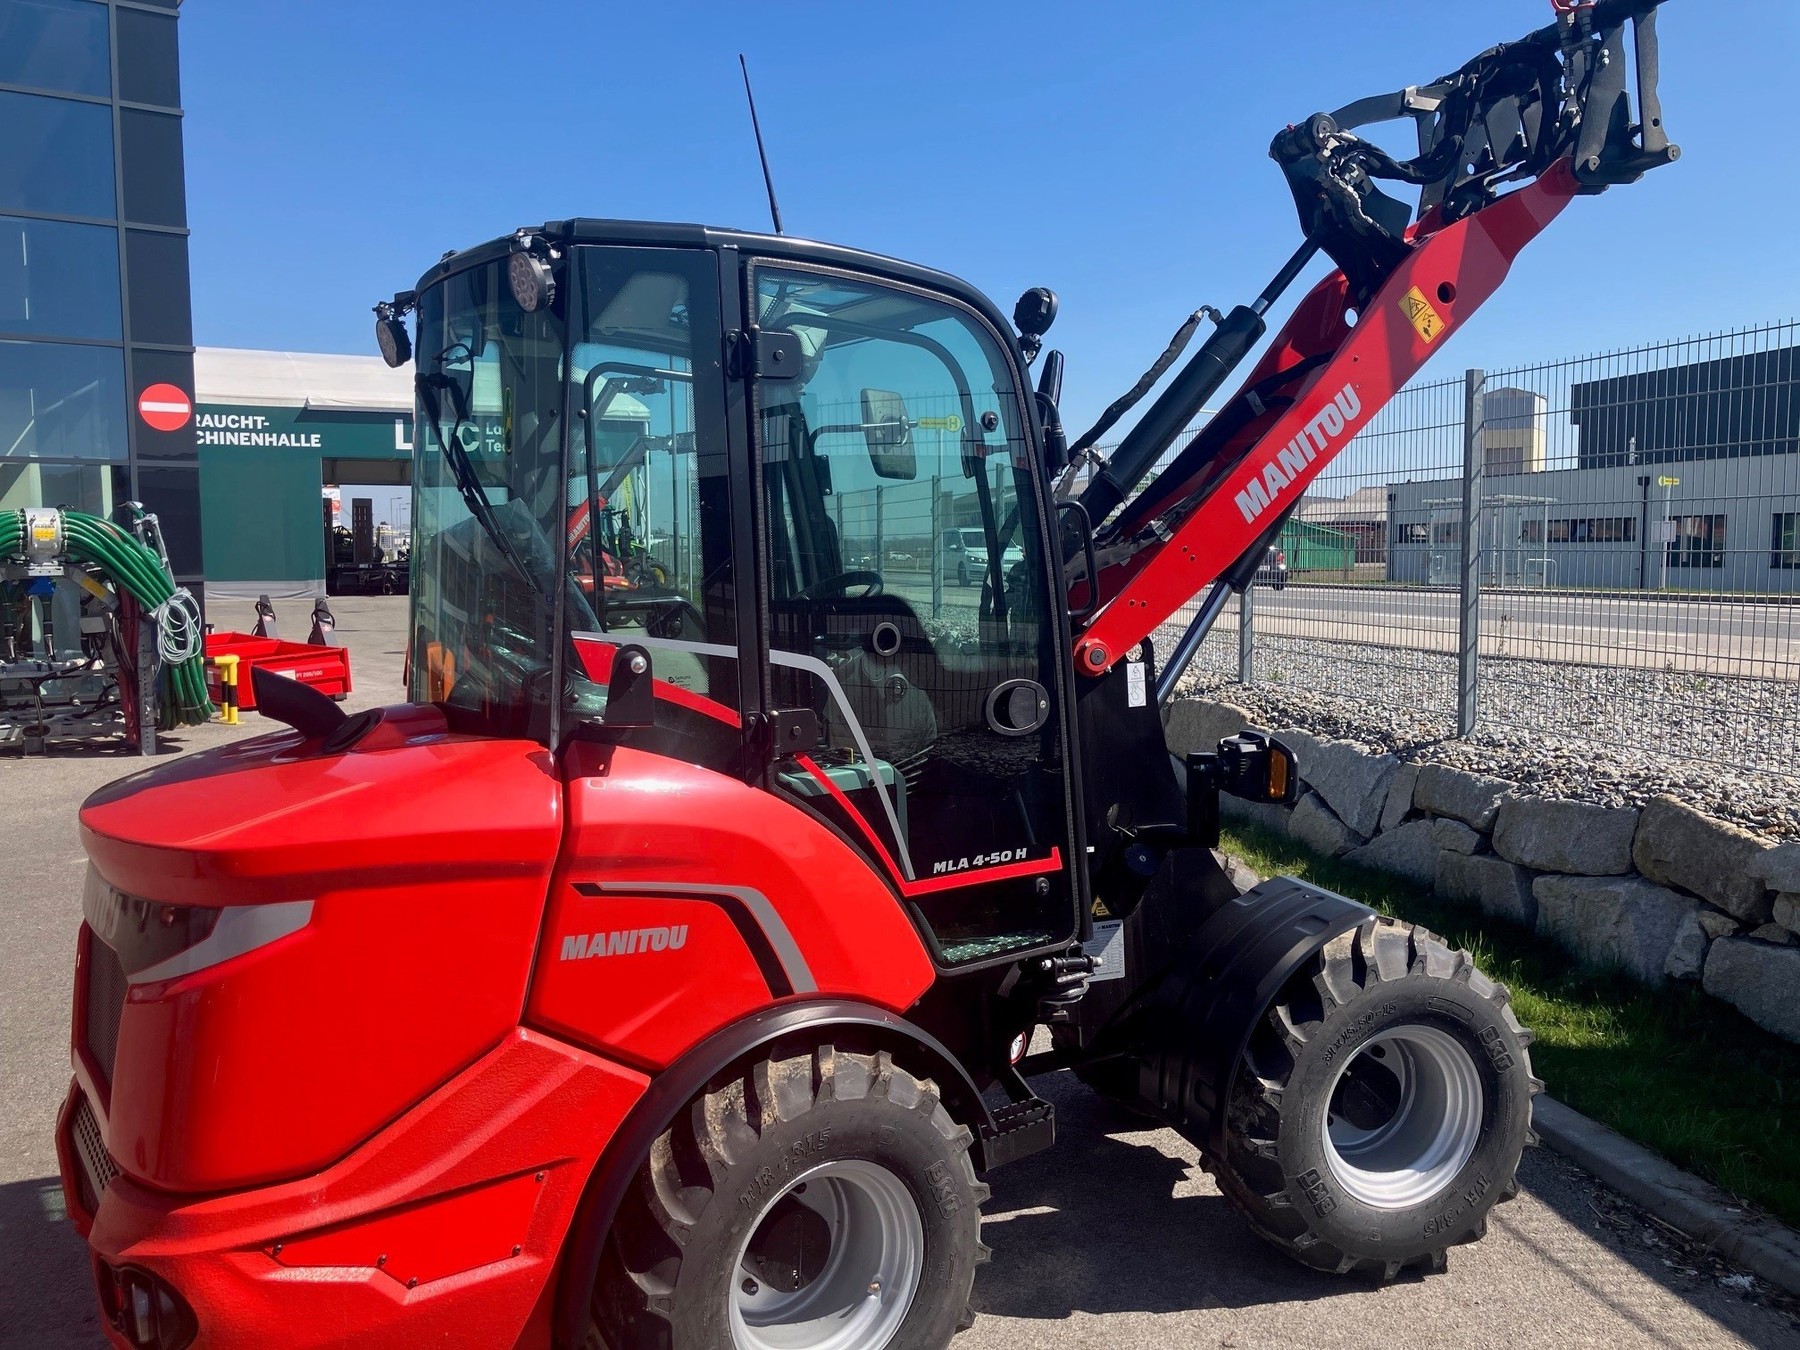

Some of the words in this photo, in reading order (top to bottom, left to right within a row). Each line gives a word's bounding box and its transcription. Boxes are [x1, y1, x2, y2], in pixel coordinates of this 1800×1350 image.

[1234, 383, 1361, 524] MANITOU
[933, 857, 969, 874] MLA
[972, 850, 1012, 866] 4-50
[1015, 847, 1028, 860] H
[560, 925, 688, 961] MANITOU
